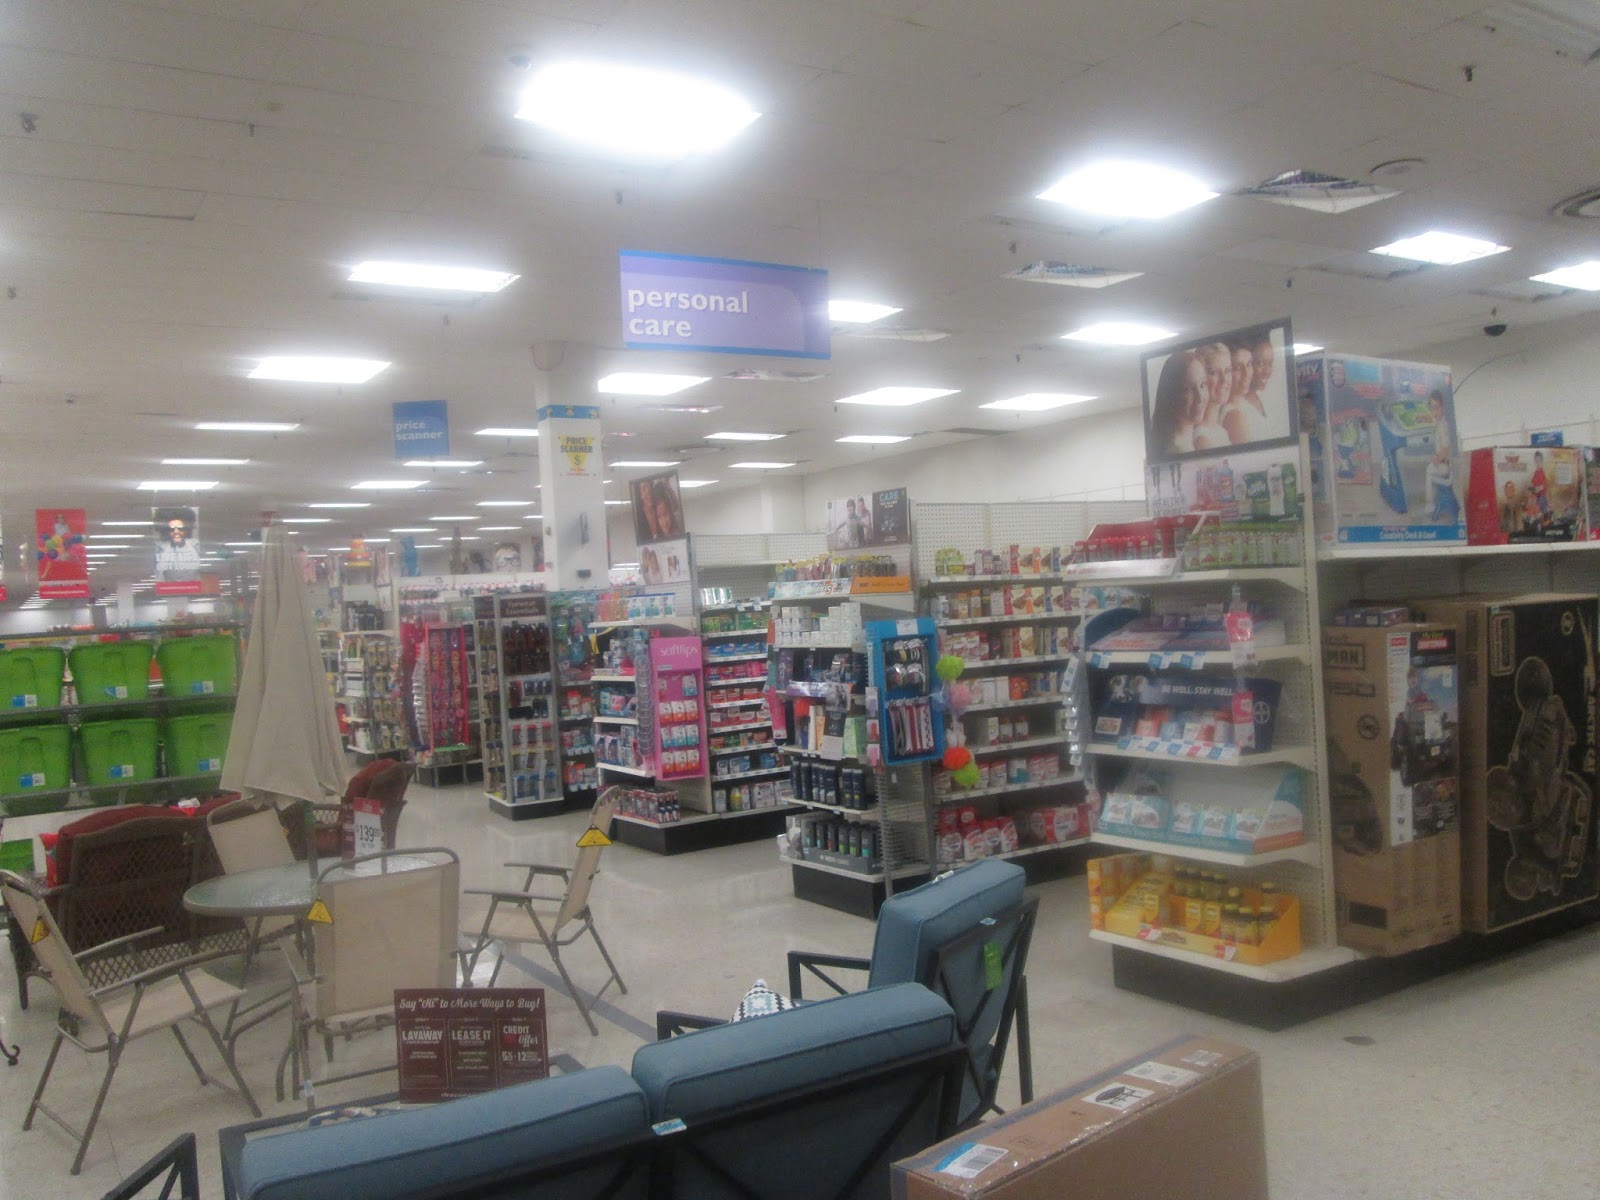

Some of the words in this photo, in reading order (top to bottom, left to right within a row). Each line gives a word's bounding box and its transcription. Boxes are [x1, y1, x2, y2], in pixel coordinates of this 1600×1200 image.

[628, 288, 748, 314] personal
[629, 315, 692, 337] care
[396, 420, 426, 432] price
[396, 431, 443, 441] scanner
[566, 437, 586, 445] PRICE
[560, 445, 594, 453] SCANNER
[660, 644, 698, 658] softlips
[399, 998, 417, 1012] Say
[439, 999, 449, 1009] to
[450, 998, 478, 1009] More
[480, 997, 504, 1012] Ways
[506, 998, 515, 1009] to
[517, 997, 541, 1012] Buy!
[402, 1030, 443, 1041] LAYAWAY
[451, 1030, 481, 1041] LEASE
[482, 1030, 492, 1041] IT
[502, 1025, 530, 1035] CREDIT
[518, 1034, 539, 1048] Offer
